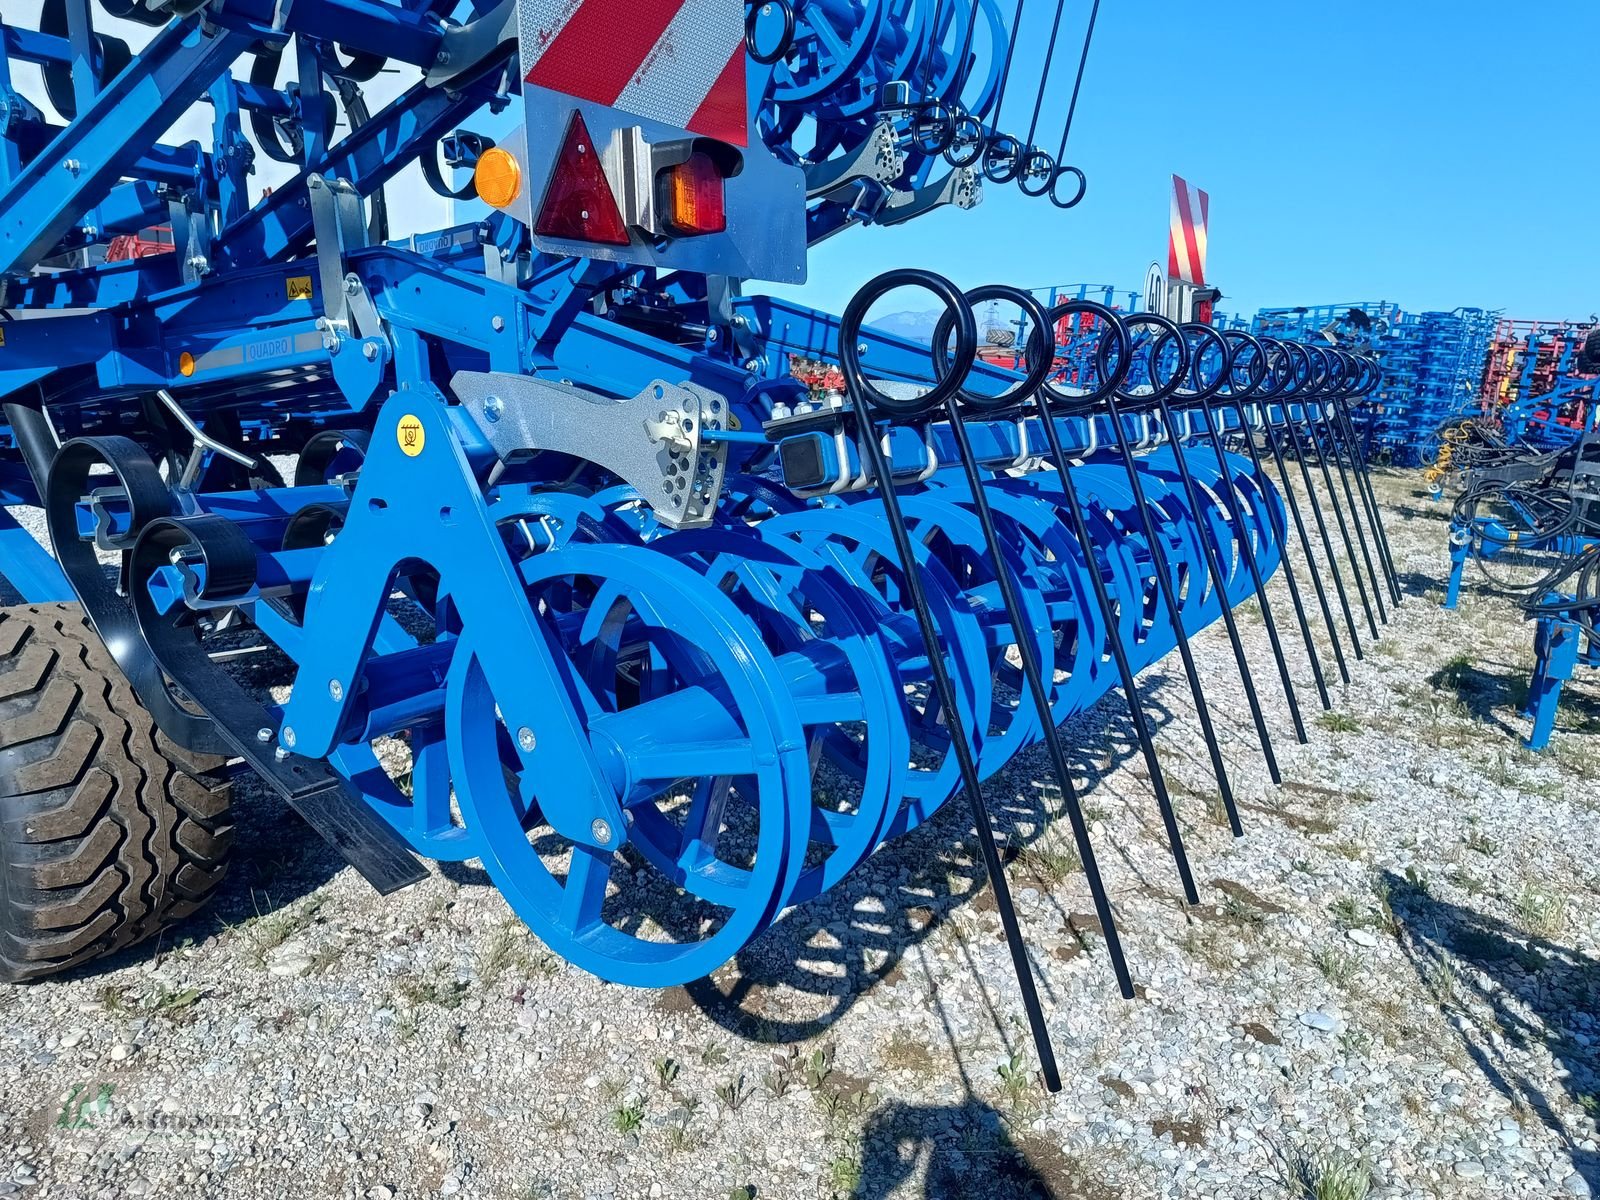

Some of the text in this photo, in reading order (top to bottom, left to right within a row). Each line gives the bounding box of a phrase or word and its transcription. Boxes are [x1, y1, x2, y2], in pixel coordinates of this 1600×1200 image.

[419, 236, 448, 252] QUADRO
[1148, 273, 1161, 315] 40
[249, 340, 288, 359] QUADRO
